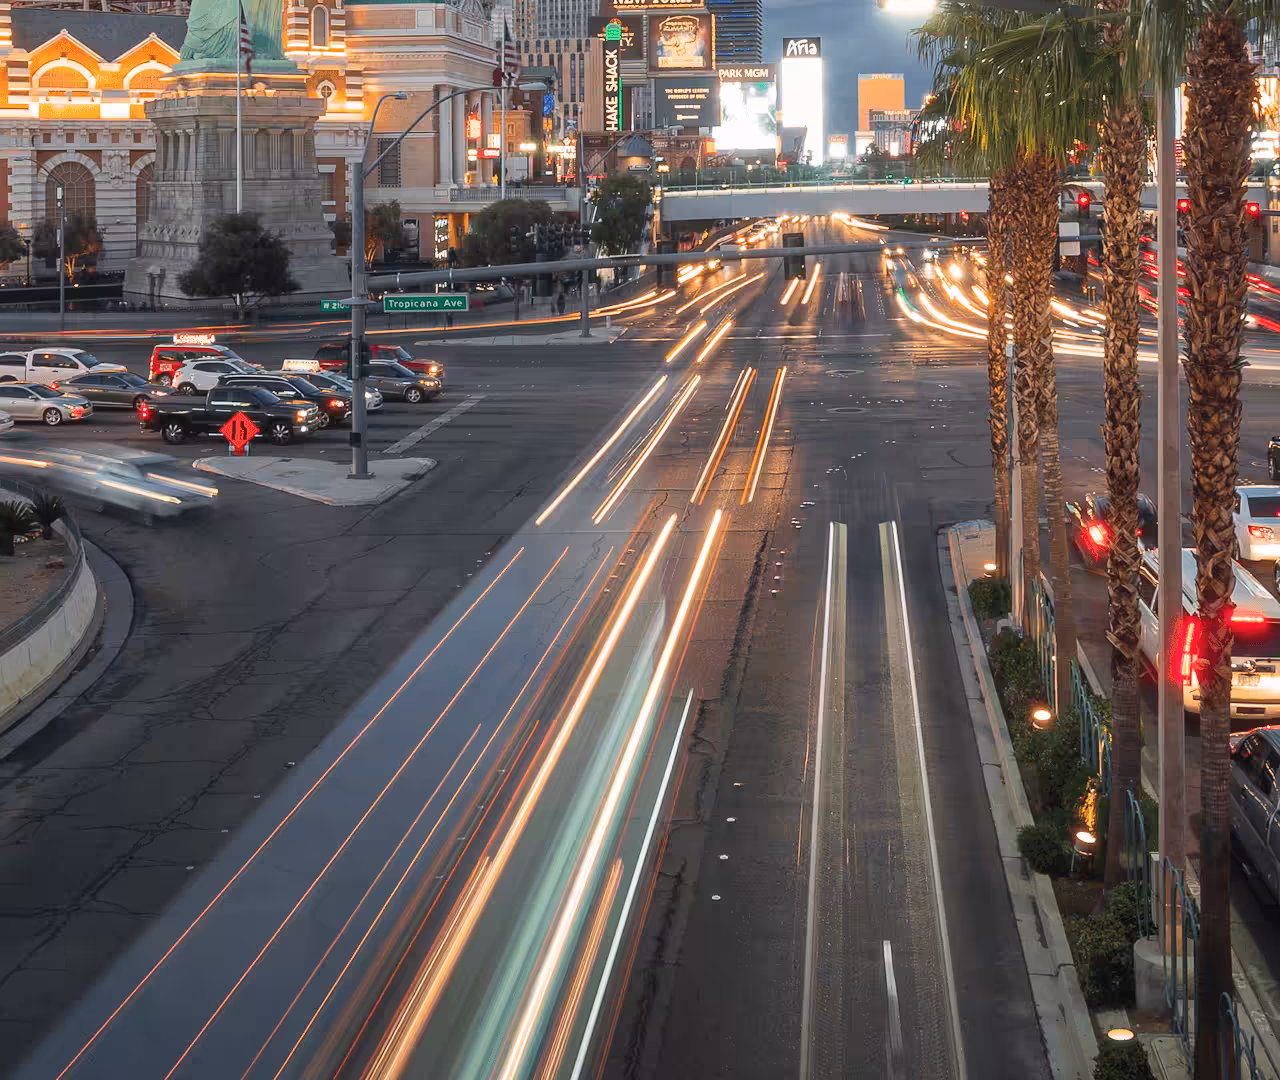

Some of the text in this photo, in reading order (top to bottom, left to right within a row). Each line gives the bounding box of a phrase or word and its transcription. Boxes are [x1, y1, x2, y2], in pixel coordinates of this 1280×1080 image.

[786, 39, 817, 56] Aria
[605, 49, 618, 92] SHACK
[719, 69, 768, 78] PARK MGM
[605, 96, 619, 131] HAKE
[389, 299, 462, 309] Tropicana Ave
